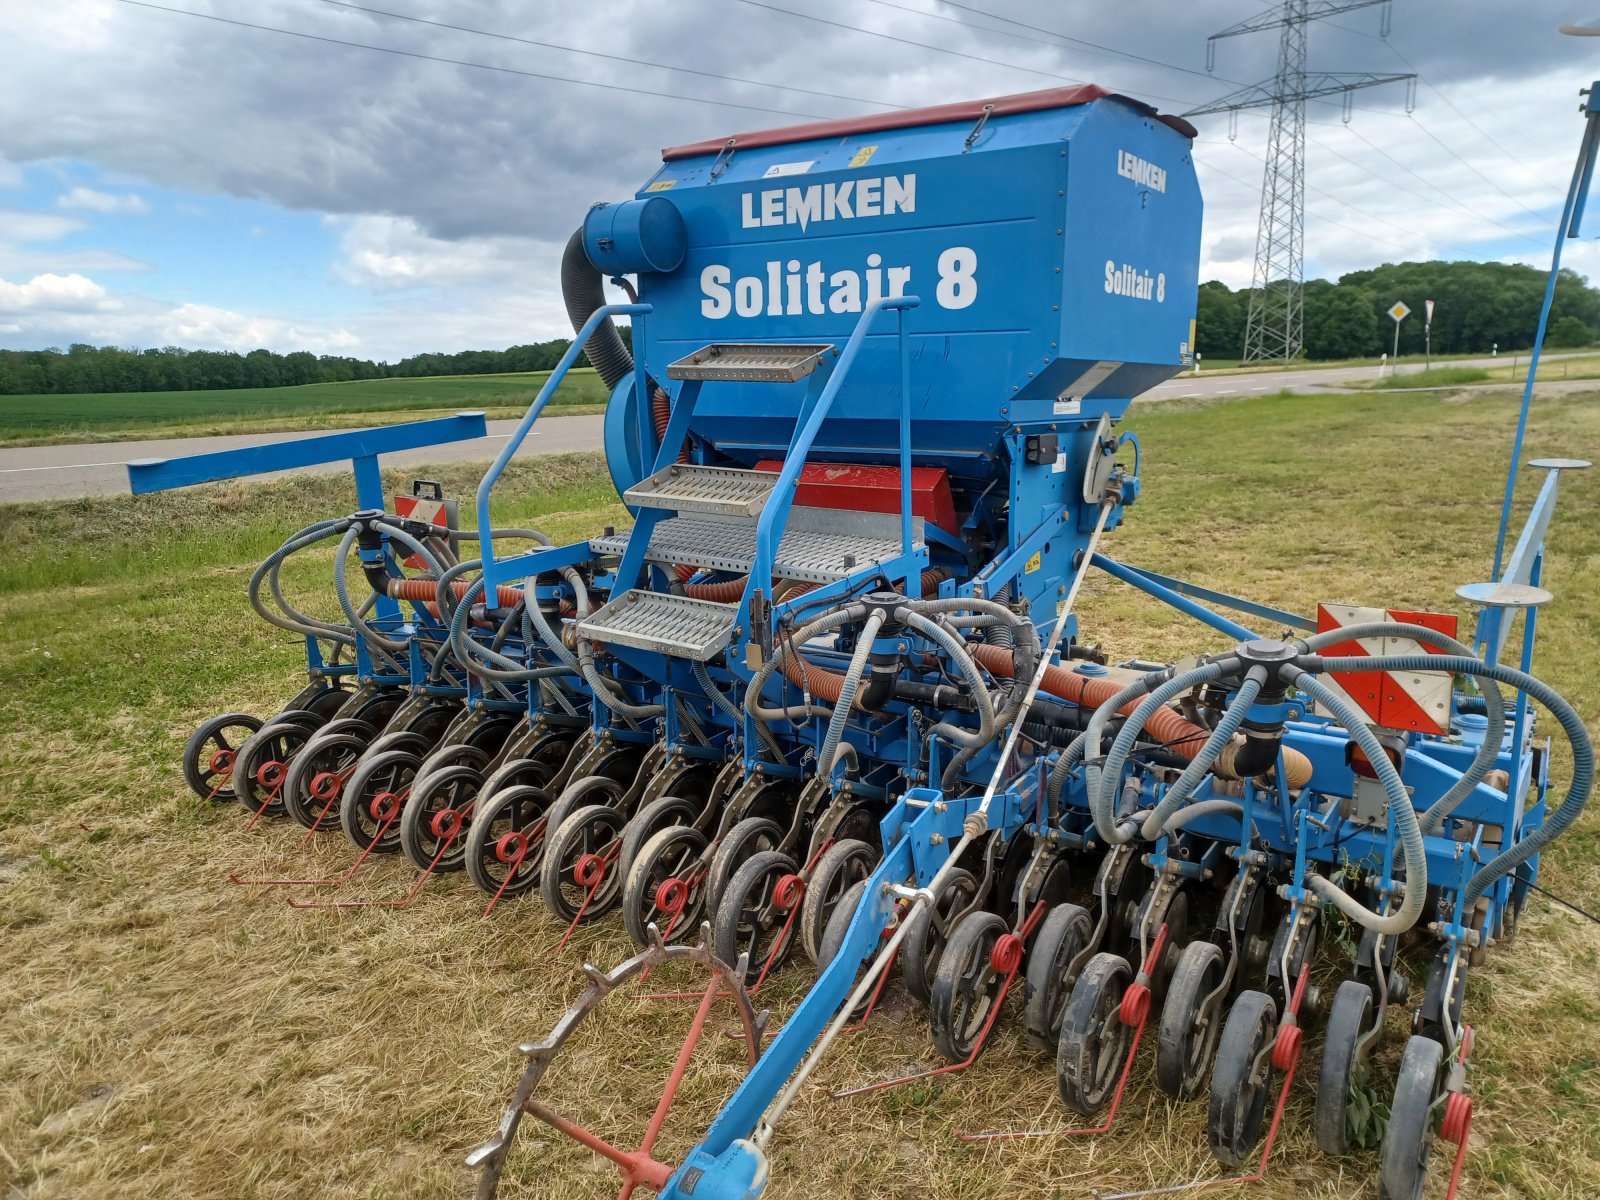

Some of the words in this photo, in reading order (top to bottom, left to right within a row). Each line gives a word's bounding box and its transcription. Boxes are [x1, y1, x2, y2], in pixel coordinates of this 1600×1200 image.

[1117, 149, 1167, 193] LEMKEN
[741, 173, 916, 232] LEMKEN
[700, 253, 911, 319] Solitair
[936, 246, 978, 310] 8
[1104, 260, 1154, 301] Solitair
[1156, 272, 1166, 304] 8
